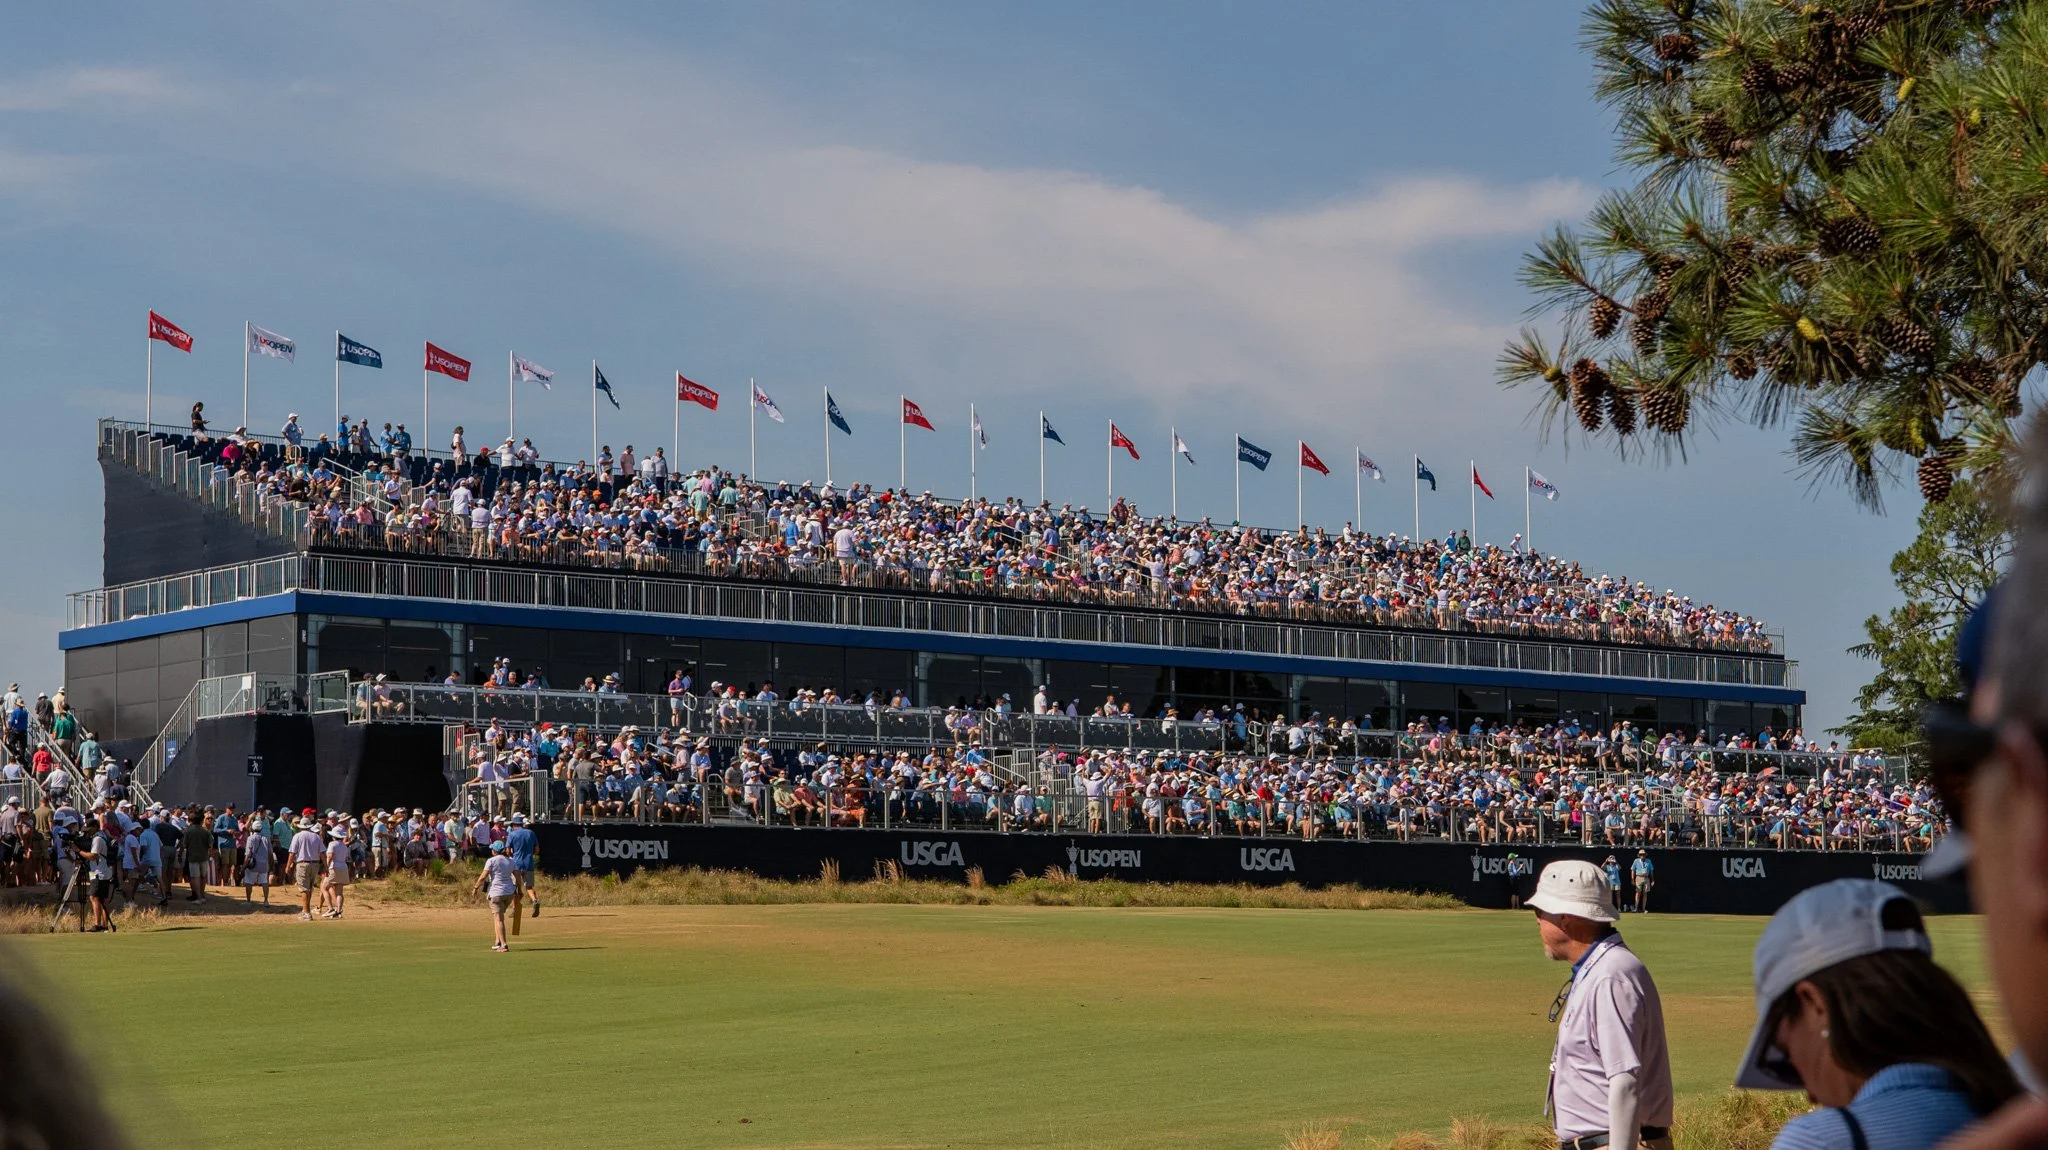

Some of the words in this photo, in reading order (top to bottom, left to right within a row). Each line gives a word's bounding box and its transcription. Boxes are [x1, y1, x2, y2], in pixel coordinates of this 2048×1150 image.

[434, 355, 467, 373] USOPEN
[594, 839, 669, 860] USOPEN
[901, 840, 966, 867] USGA
[1080, 849, 1141, 868] USOPEN
[1240, 847, 1296, 872] USGA
[1482, 857, 1534, 875] USOEN
[1722, 857, 1767, 879] USGA
